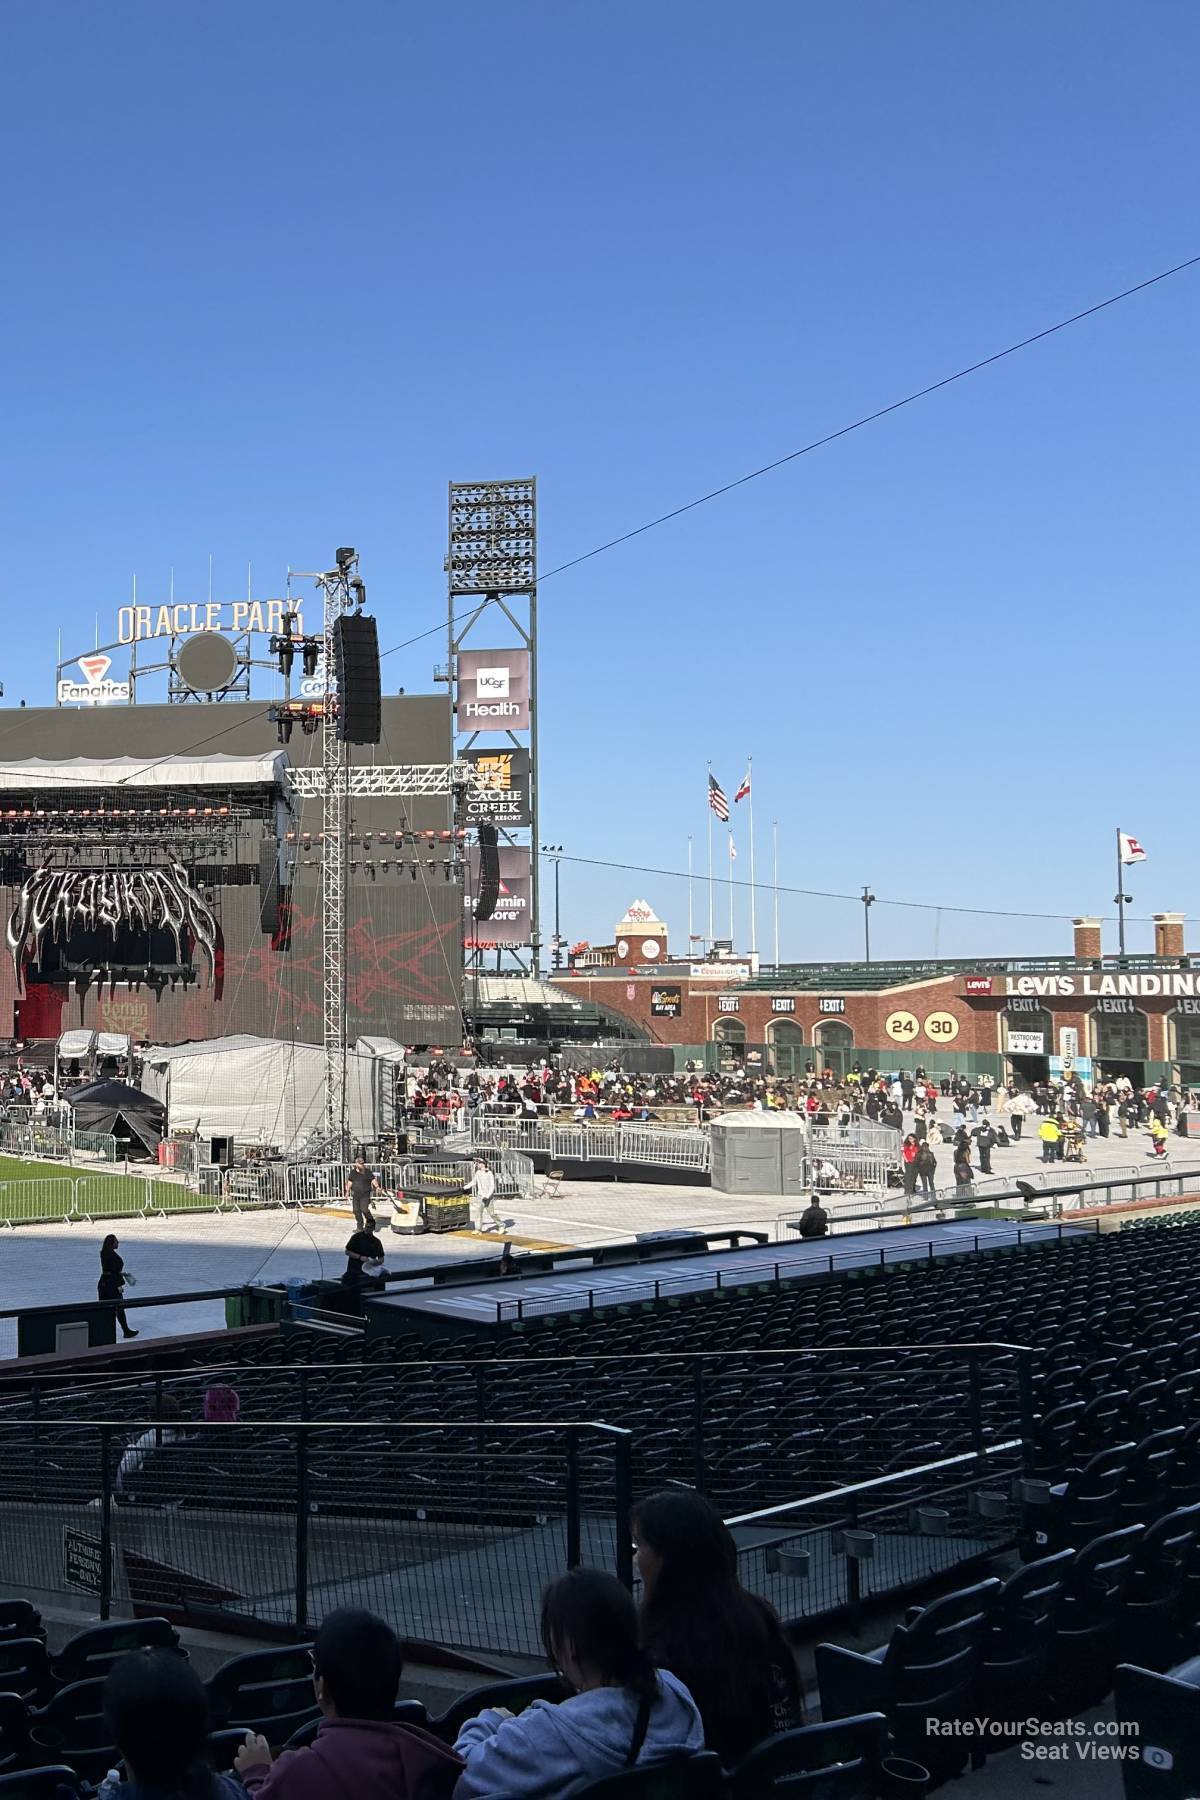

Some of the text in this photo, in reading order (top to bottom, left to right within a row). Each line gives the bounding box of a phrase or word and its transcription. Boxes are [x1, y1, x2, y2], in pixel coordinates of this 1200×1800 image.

[117, 601, 221, 644] ORACLE
[480, 677, 505, 689] UCSF
[60, 683, 129, 699] Fanatics
[466, 702, 520, 717] Health
[466, 790, 522, 801] CACHE
[468, 802, 521, 813] CREEK
[464, 895, 525, 907] Bemin
[1083, 974, 1200, 996] LANDIN
[722, 1000, 735, 1012] EXIT
[776, 999, 791, 1011] EXIT
[823, 999, 840, 1012] EXIT
[1012, 999, 1034, 1012] EXIT
[1103, 999, 1128, 1013] EXIT
[1183, 999, 1200, 1014] EX
[891, 1020, 914, 1033] 24
[931, 1020, 953, 1034] 30
[1010, 1033, 1042, 1042] RESTROOMS
[69, 1552, 102, 1575] PERSONN
[79, 1568, 98, 1586] ONLY
